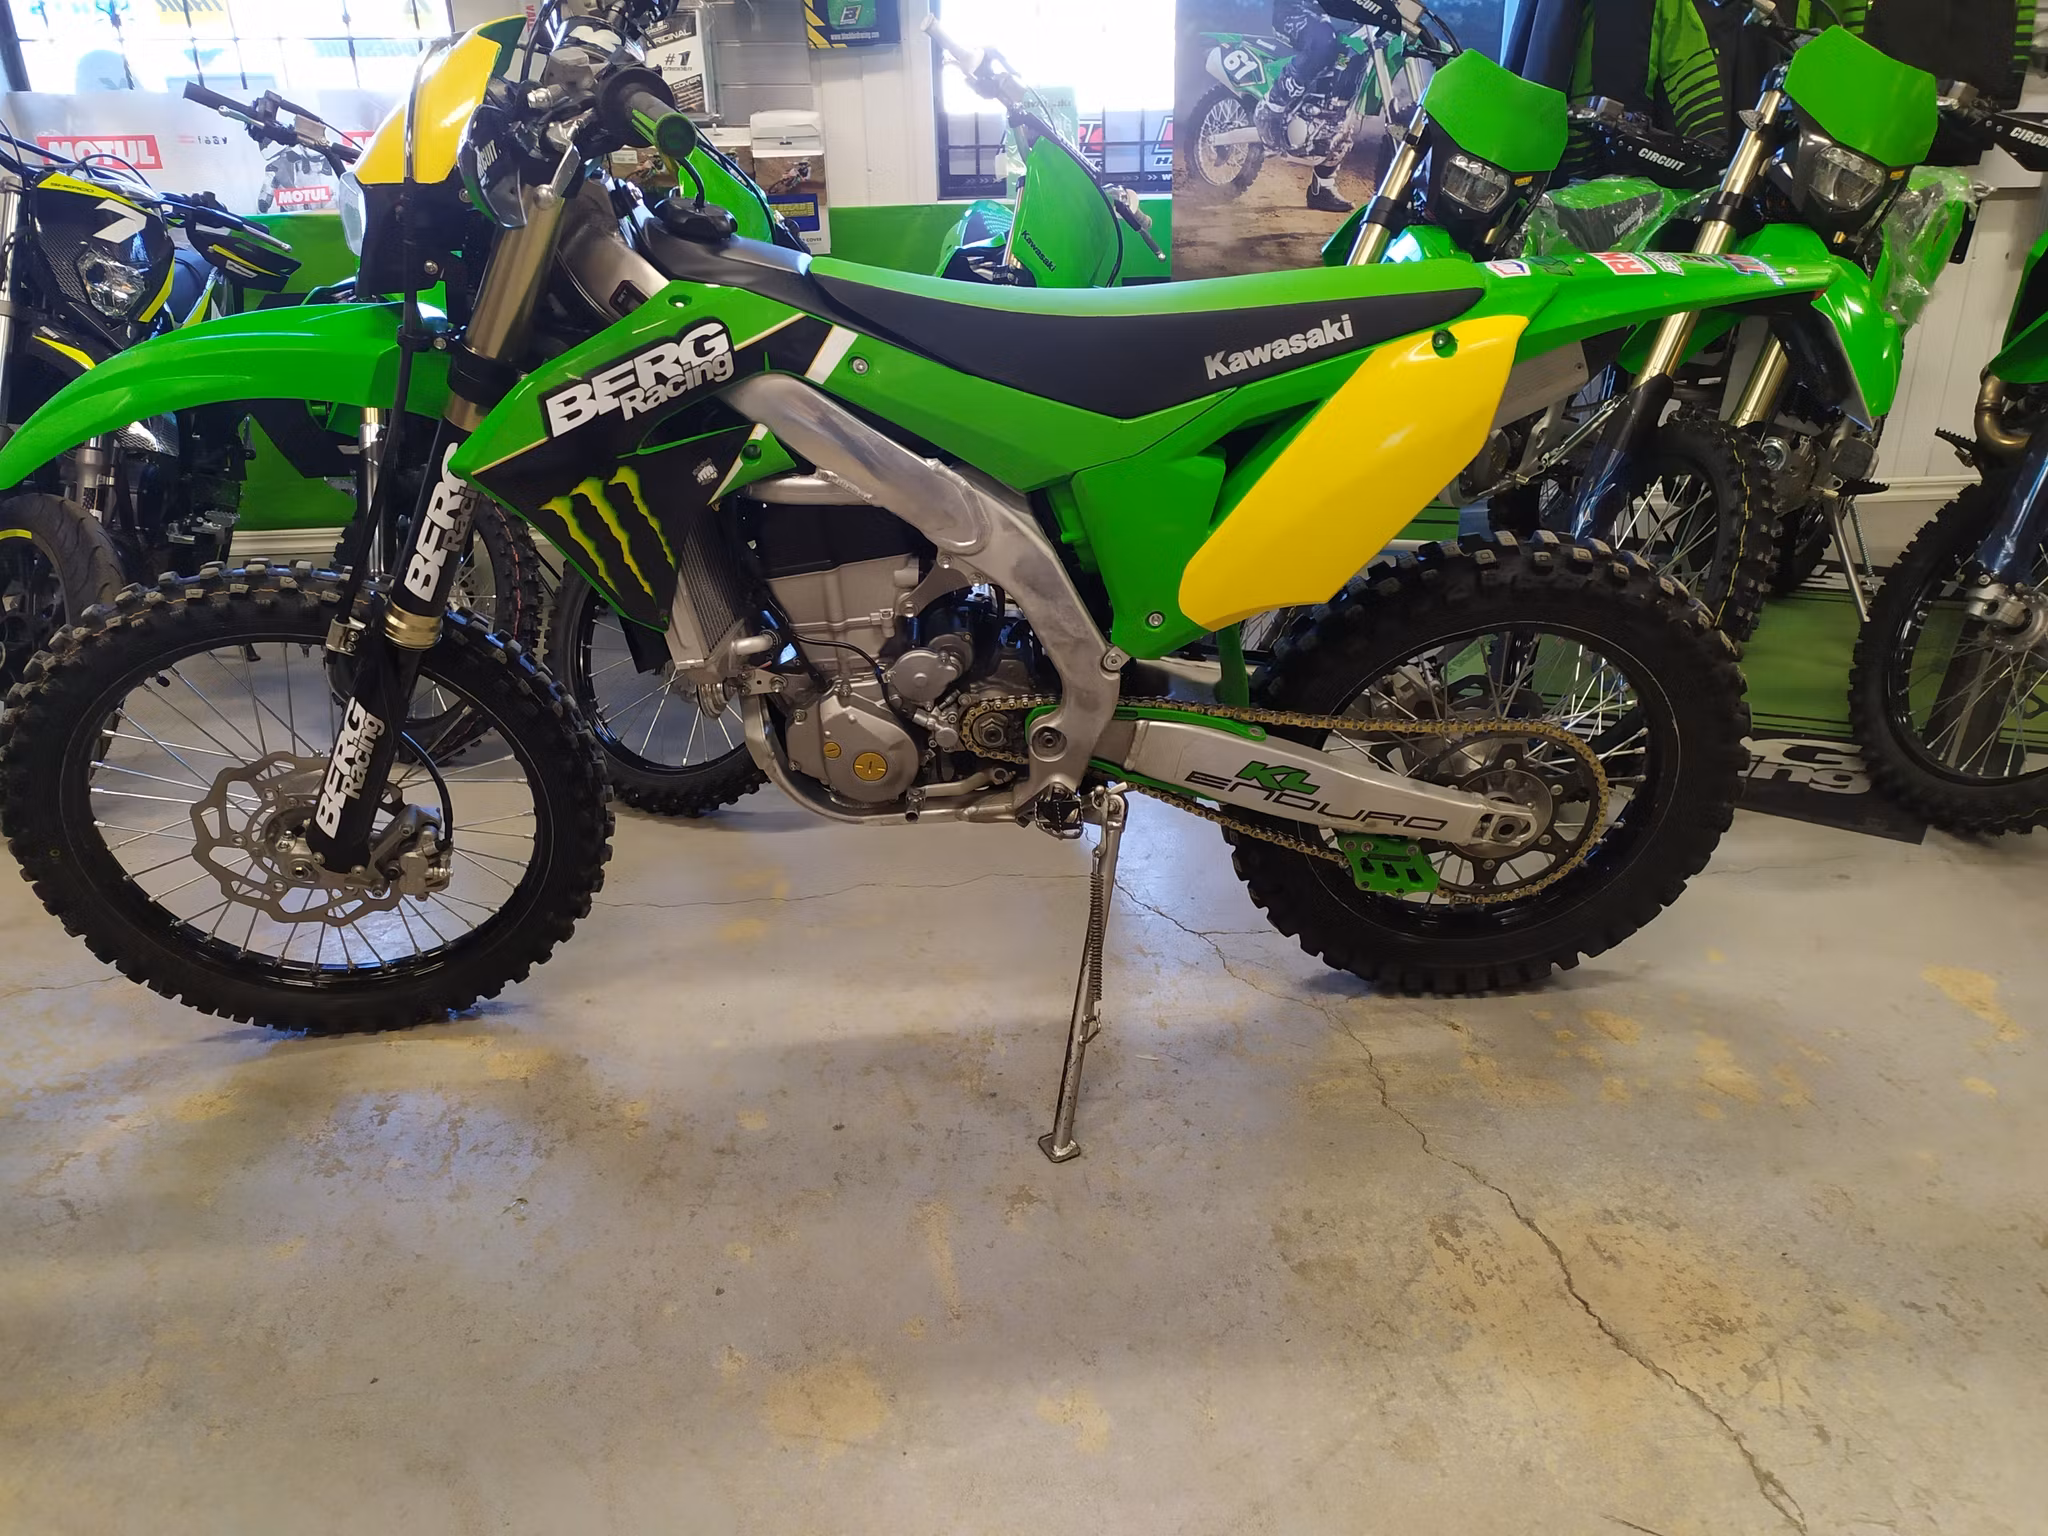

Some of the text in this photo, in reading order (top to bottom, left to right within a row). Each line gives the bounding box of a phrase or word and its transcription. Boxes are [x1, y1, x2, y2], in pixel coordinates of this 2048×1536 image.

[1223, 50, 1258, 80] 61
[673, 76, 701, 91] COVER
[46, 140, 156, 166] MOTUL
[2009, 126, 2048, 149] CIRCU
[1638, 147, 1687, 172] CIRCUIT
[278, 187, 329, 205] MOTUL
[1021, 229, 1057, 273] Kawasaki
[1204, 313, 1354, 380] Kawasaki
[546, 322, 730, 438] BERG
[618, 350, 735, 422] Racing
[315, 696, 367, 840] BERG
[340, 711, 386, 800] Racing
[1235, 760, 1321, 796] KL
